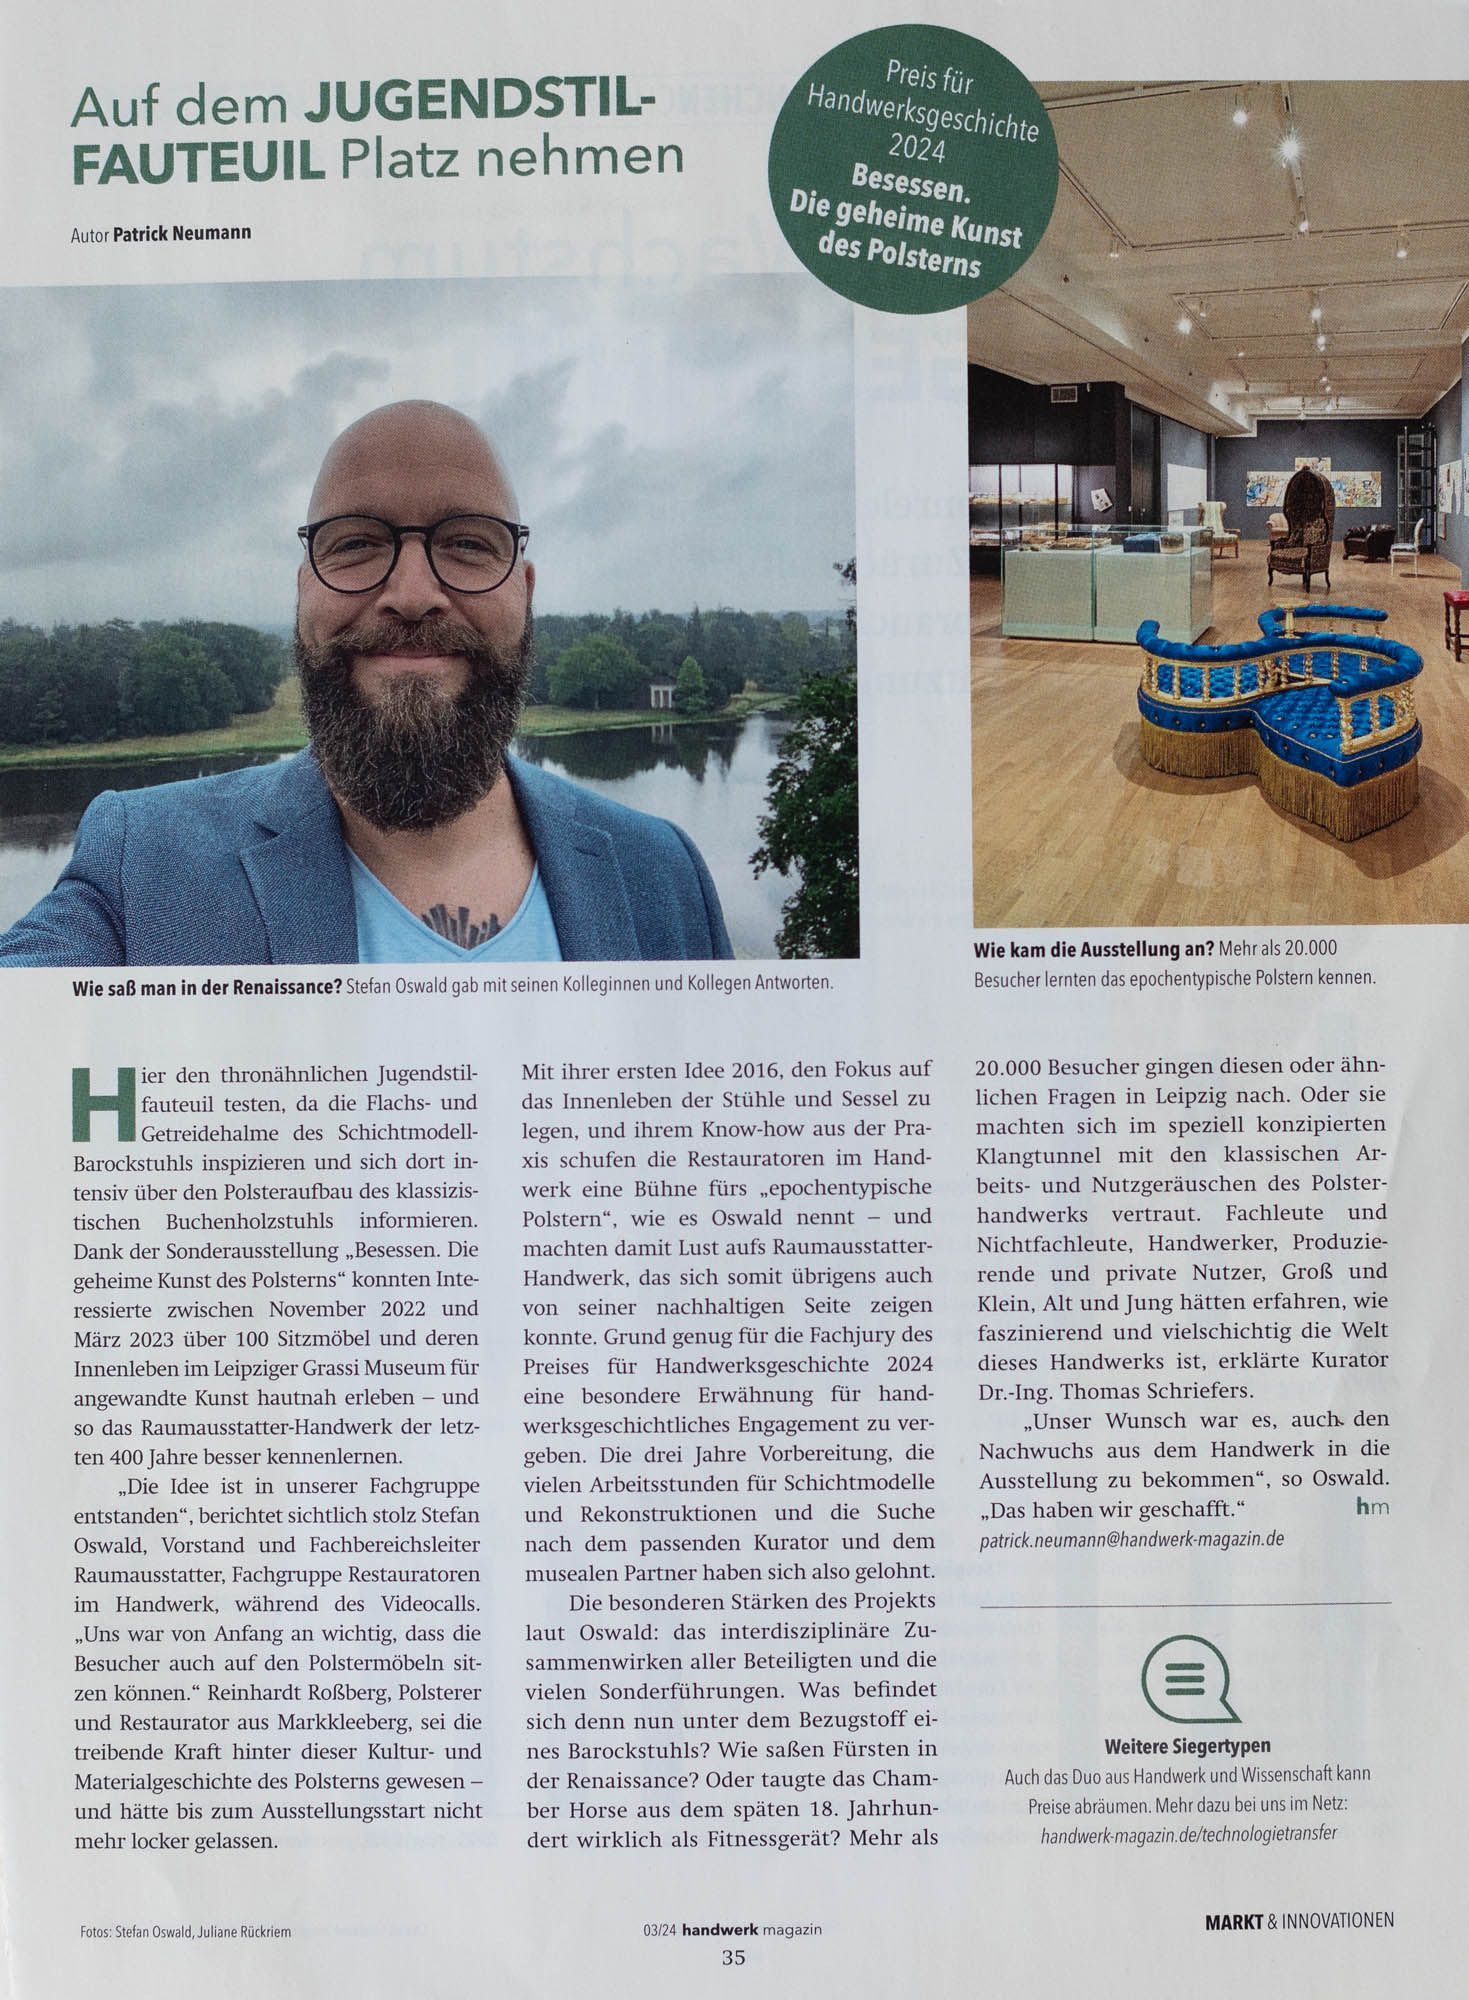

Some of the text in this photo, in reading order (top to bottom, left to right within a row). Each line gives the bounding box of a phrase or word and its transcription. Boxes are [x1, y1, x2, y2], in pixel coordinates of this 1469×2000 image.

[886, 58, 974, 95] Preis für
[70, 82, 161, 128] Auf
[176, 81, 287, 126] dem
[807, 82, 1040, 143] Handwerksgeschichte
[73, 131, 683, 186] FAUTEUIL Platz nehmen
[888, 132, 945, 164] 2024
[851, 162, 971, 204] Besessen.
[789, 188, 1023, 249] Die geheime Kunst
[70, 224, 252, 244] Autor Patrick Neumann
[818, 229, 982, 279] des Polsterns
[973, 938, 1338, 962] Wie kam die Ausstellung an? Mehr als 20.000
[72, 973, 834, 998] Wie saß man in der Renaissance? Stefan Oswald gab mit seinen Kolleginnen und Kollegen Antworten.
[974, 967, 1377, 992] Besucher lernten das epochentypische Polstern kennen.
[175, 1066, 211, 1084] den
[220, 1065, 369, 1084] thronähnlichen
[141, 1124, 279, 1143] Getreidehalme
[292, 1124, 324, 1141] des
[521, 1151, 549, 1169] xis
[559, 1150, 637, 1169] schufen
[647, 1150, 677, 1168] die
[687, 1150, 825, 1168] Restauratoren
[835, 1148, 863, 1166] im
[72, 1210, 478, 1231] tischen Buchenholzstuhls informieren.
[976, 1202, 1388, 1224] handwerks vertraut. Fachleute und
[73, 1299, 480, 1319] ressierte zwischen November 2022 und
[977, 1351, 1390, 1372] dieses Handwerks ist, erklärte Kurator
[523, 1387, 565, 1405] eine
[581, 1386, 681, 1405] besondere
[698, 1385, 814, 1408] Erwähnung
[830, 1384, 862, 1403] für
[978, 1380, 1254, 1405] Dr.-Ing. Thomas Schriefers.
[524, 1502, 936, 1523] und Rekonstruktionen und die Suche
[1032, 1500, 1094, 1519] haben
[1098, 1500, 1134, 1518] wir
[1356, 1495, 1390, 1516] hm
[73, 1535, 481, 1556] Oswald, Vorstand und Fachbereichsleiter
[979, 1528, 1285, 1553] patrick.neumann@handwerk-magazin.de
[74, 1565, 481, 1588] Raumausstatter, Fachgruppe Restauratoren
[524, 1679, 938, 1704] vielen Sonderführungen. Was befindet
[1104, 1737, 1271, 1759] Weitere Siegertypen
[1004, 1763, 1371, 1786] Auch das Duo aus Handwerk und Wissenschaft kann
[74, 1801, 484, 1824] und hätte bis zum Ausstellungsstart nicht
[1028, 1794, 1348, 1815] Preise abräumen. Mehr dazu bei uns im Netz:
[74, 1831, 127, 1850] mehr
[131, 1831, 190, 1850] locker
[194, 1831, 279, 1854] gelassen.
[1040, 1822, 1339, 1848] handwerk-magazin.de/technologietransfer
[80, 1925, 112, 1938] Fotos:
[115, 1924, 150, 1939] Stefan
[152, 1924, 195, 1940] Oswald,
[197, 1924, 238, 1939] Juliane
[240, 1924, 292, 1938] Rückriem
[643, 1922, 823, 1940] 03/24 handwerk magazin
[1205, 1911, 1395, 1931] MARKT & INNOVATIONEN
[722, 1949, 746, 1966] 35
